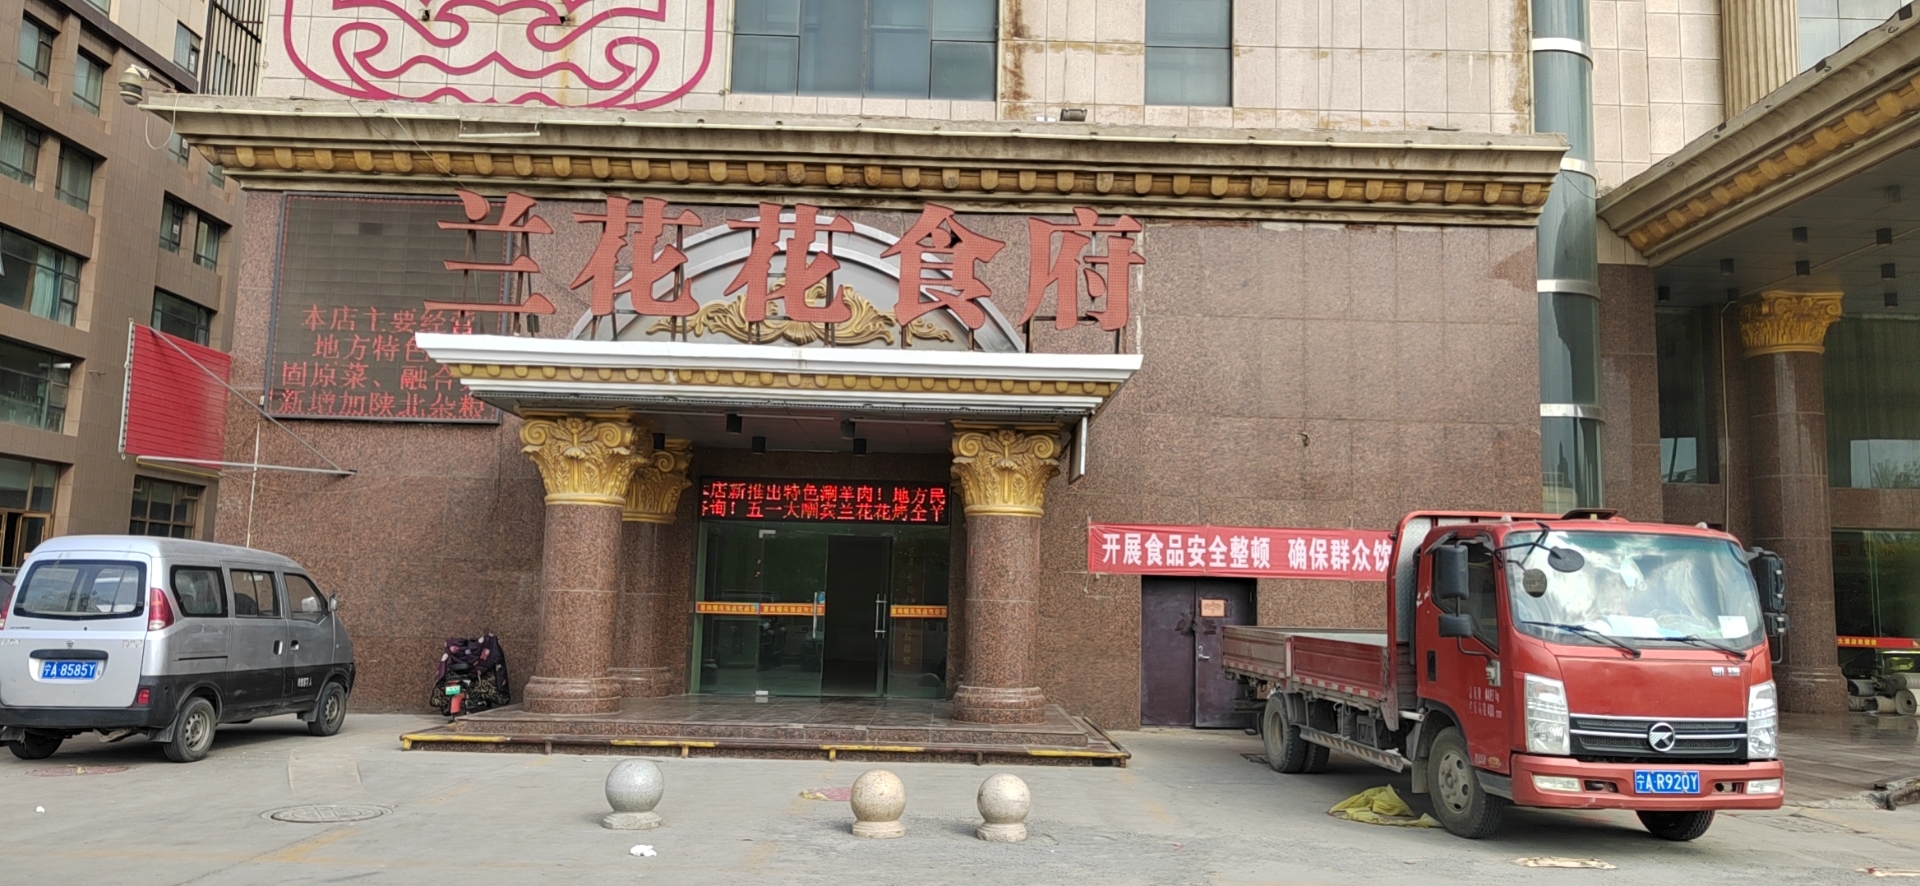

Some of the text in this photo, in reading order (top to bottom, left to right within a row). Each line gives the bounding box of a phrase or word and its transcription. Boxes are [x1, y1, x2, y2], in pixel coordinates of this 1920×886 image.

[424, 187, 1146, 332] 兰花花食府
[301, 303, 476, 333] 本店主要经营
[312, 333, 430, 362] 地方特色
[281, 360, 469, 391] 固原菜、融合
[1102, 533, 1392, 572] 开展食品安全整顿 确保群众饮
